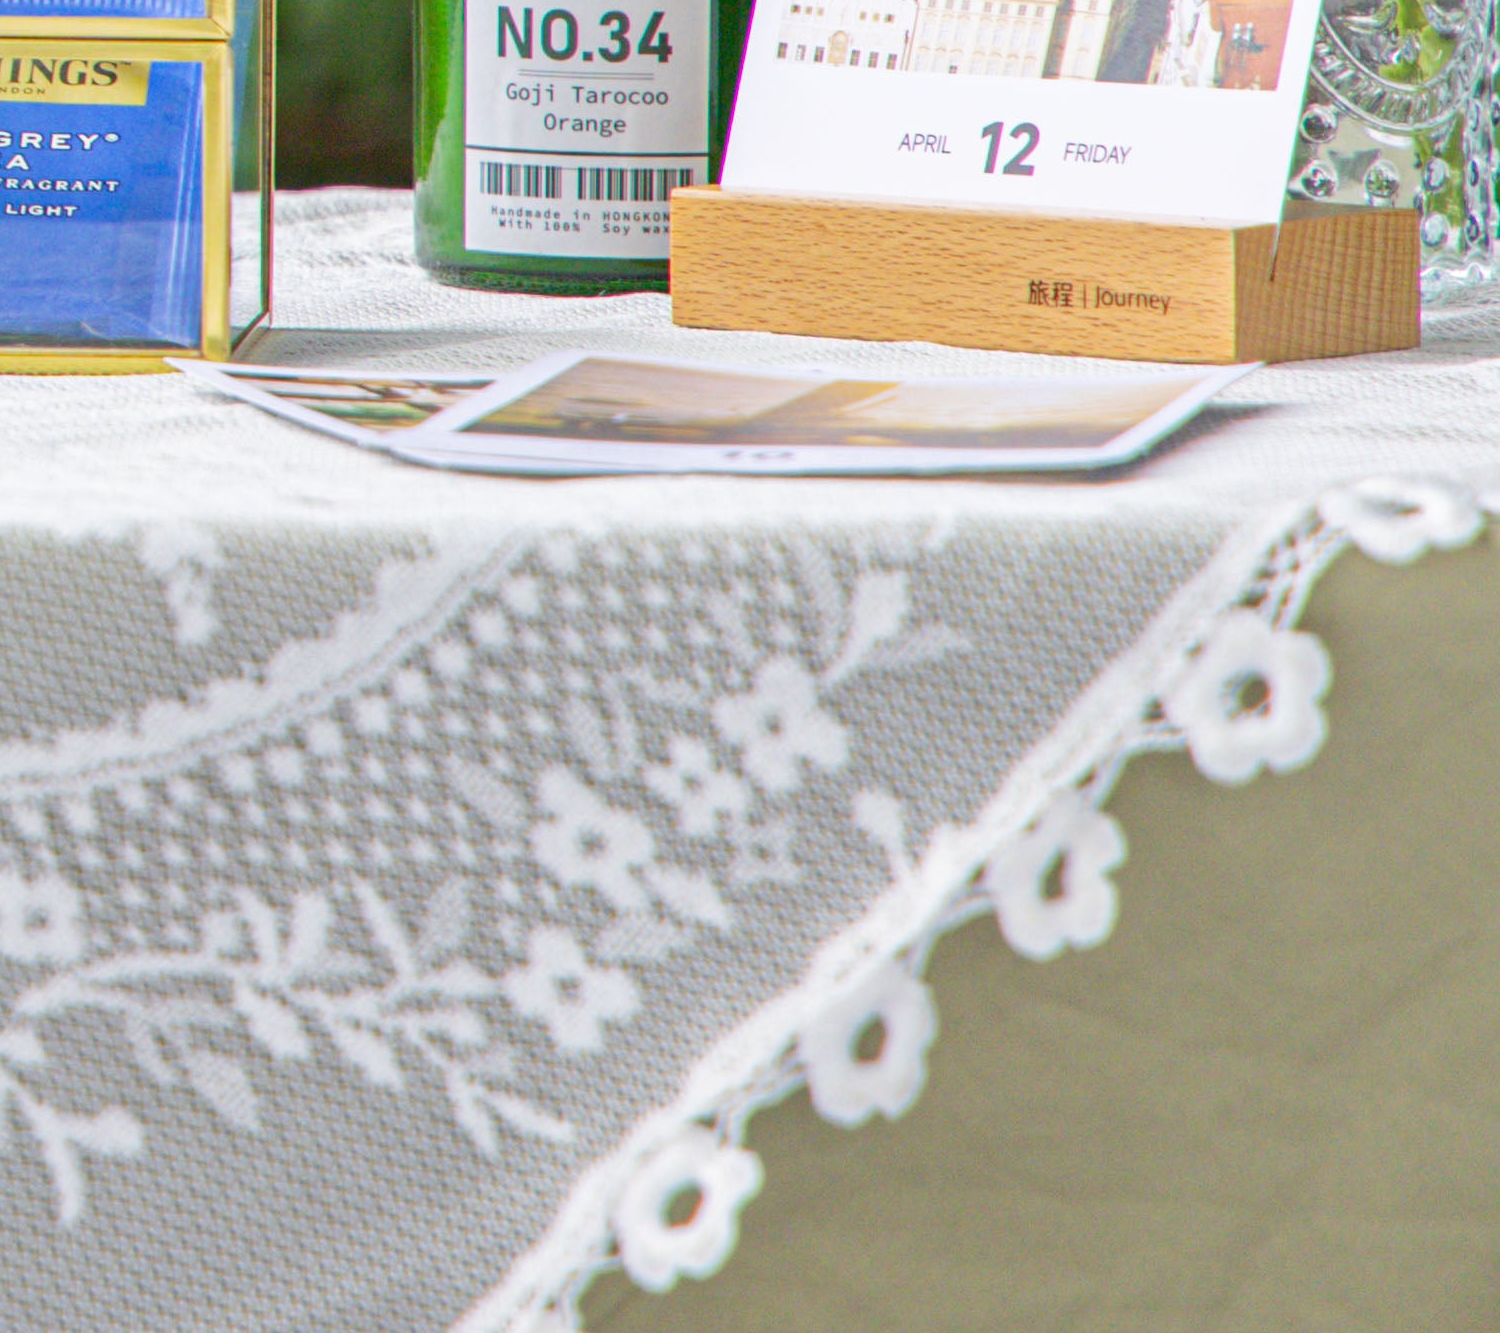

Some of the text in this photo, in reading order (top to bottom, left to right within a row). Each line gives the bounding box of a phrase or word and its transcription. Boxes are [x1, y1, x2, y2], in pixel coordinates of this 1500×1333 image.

[497, 5, 673, 63] NO.34
[505, 82, 669, 106] Goji Tarocoo
[543, 113, 627, 137] Orange
[897, 121, 1133, 176] APRIL 12 FRIDAY
[5, 202, 78, 218] LIGHT
[491, 205, 561, 220] Handmade
[573, 209, 591, 221] in
[498, 217, 670, 236] With 100% Soy wax
[1028, 279, 1172, 315] 旅程 Journey
